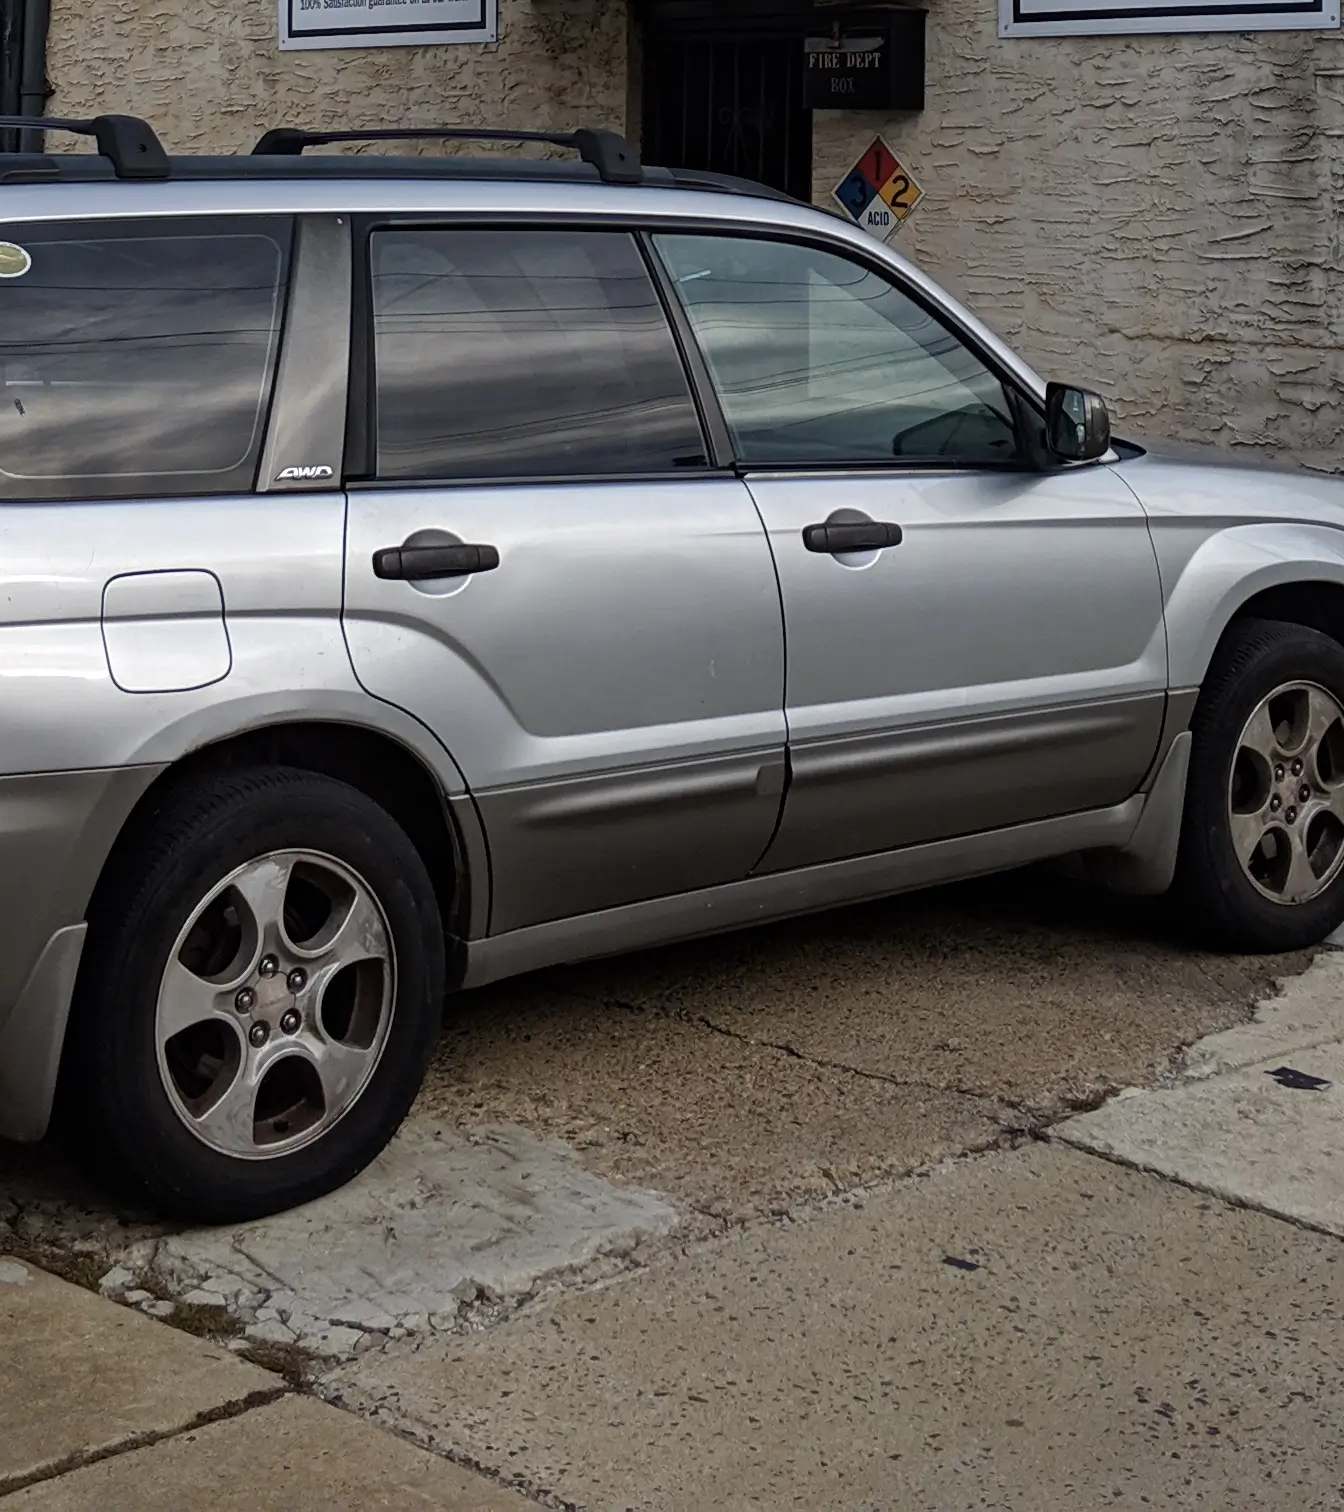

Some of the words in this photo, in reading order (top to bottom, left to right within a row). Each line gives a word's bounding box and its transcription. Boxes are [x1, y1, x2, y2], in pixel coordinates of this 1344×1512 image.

[809, 52, 840, 68] FIRE
[846, 52, 882, 68] DEPT
[830, 77, 855, 93] BOX
[872, 150, 881, 181] 1
[891, 175, 910, 208] 2
[867, 211, 889, 226] ACID
[274, 465, 333, 482] AWD
